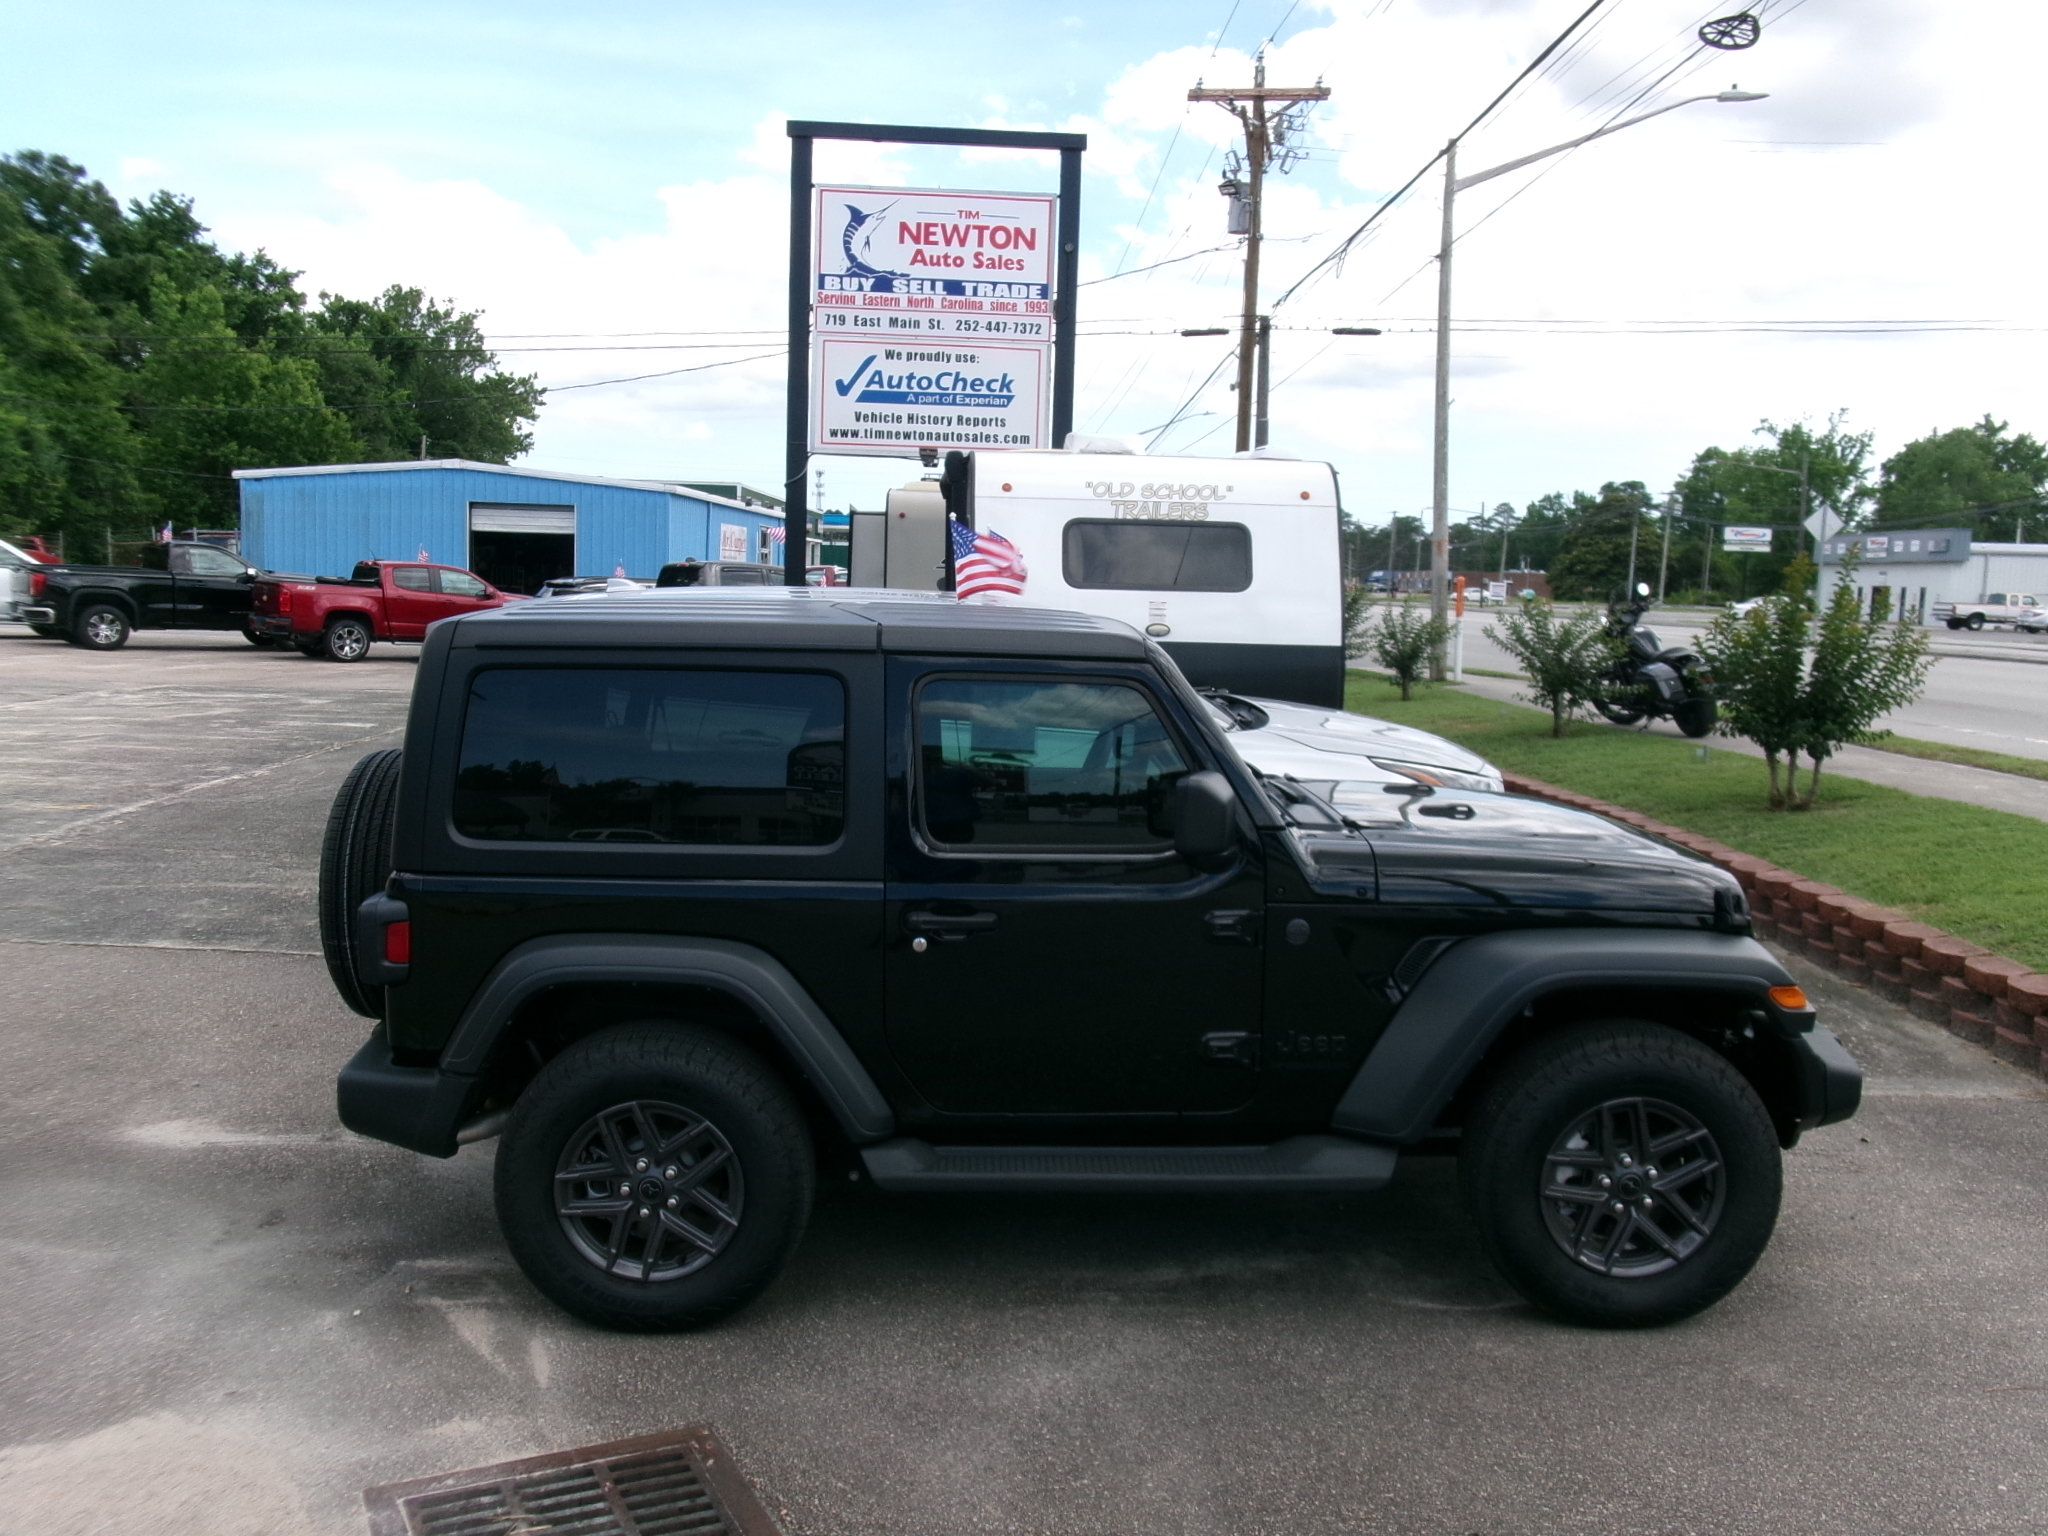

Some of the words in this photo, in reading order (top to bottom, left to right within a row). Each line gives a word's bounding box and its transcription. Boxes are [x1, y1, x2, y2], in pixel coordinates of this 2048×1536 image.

[957, 210, 980, 220] TIM
[898, 221, 1037, 251] NEWTON
[909, 248, 965, 269] Auto
[972, 251, 1025, 271] Sales
[823, 276, 876, 292] BUY
[892, 278, 948, 295] SELL
[962, 282, 1042, 299] TRADE
[817, 291, 856, 306] Serving
[862, 294, 901, 308] Eastern
[907, 295, 935, 309] North
[941, 297, 983, 311] Carolina
[990, 300, 1018, 312] since
[1025, 301, 1048, 313] 1993
[824, 313, 846, 326] 719
[853, 315, 881, 328] East
[888, 316, 921, 330] Main
[928, 318, 945, 331] St.
[955, 319, 1042, 335] 252-447-7372
[884, 349, 903, 361] We
[906, 350, 952, 364] proudly
[955, 353, 980, 364] use:
[864, 369, 1016, 394] AutoCheck
[906, 393, 916, 403] A
[918, 394, 940, 405] part
[942, 394, 954, 404] of
[956, 395, 1008, 407] Experian
[854, 411, 903, 424] Vehicle
[907, 412, 953, 427] History
[957, 415, 1007, 428] Reports
[829, 428, 1031, 445] www.timnewtonautosales.com
[1111, 500, 1210, 521] TRAILERS
[1275, 1030, 1347, 1056] Jeep
